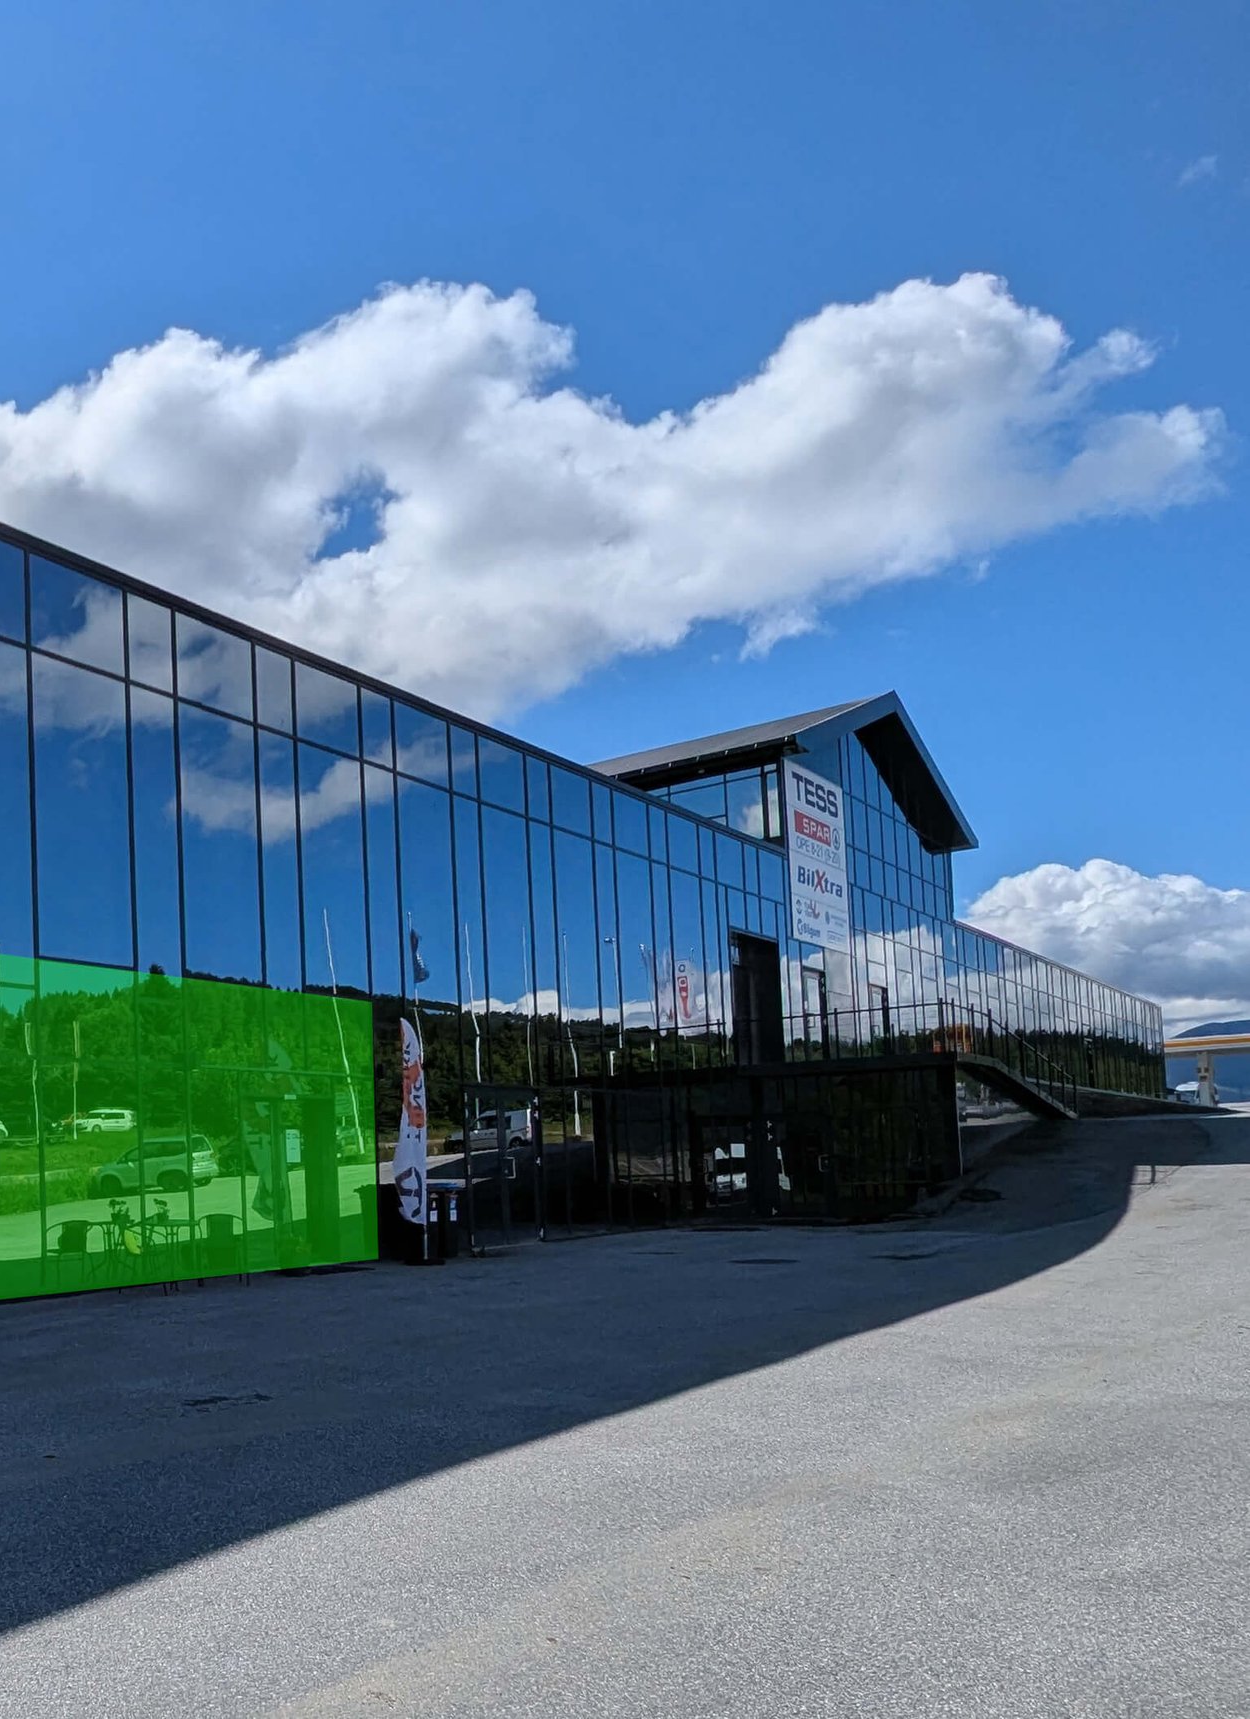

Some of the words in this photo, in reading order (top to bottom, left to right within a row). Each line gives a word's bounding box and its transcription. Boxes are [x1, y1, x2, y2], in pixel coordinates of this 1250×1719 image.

[791, 772, 838, 818] TESS
[802, 818, 830, 841] SPAR
[797, 865, 843, 898] BilXtra
